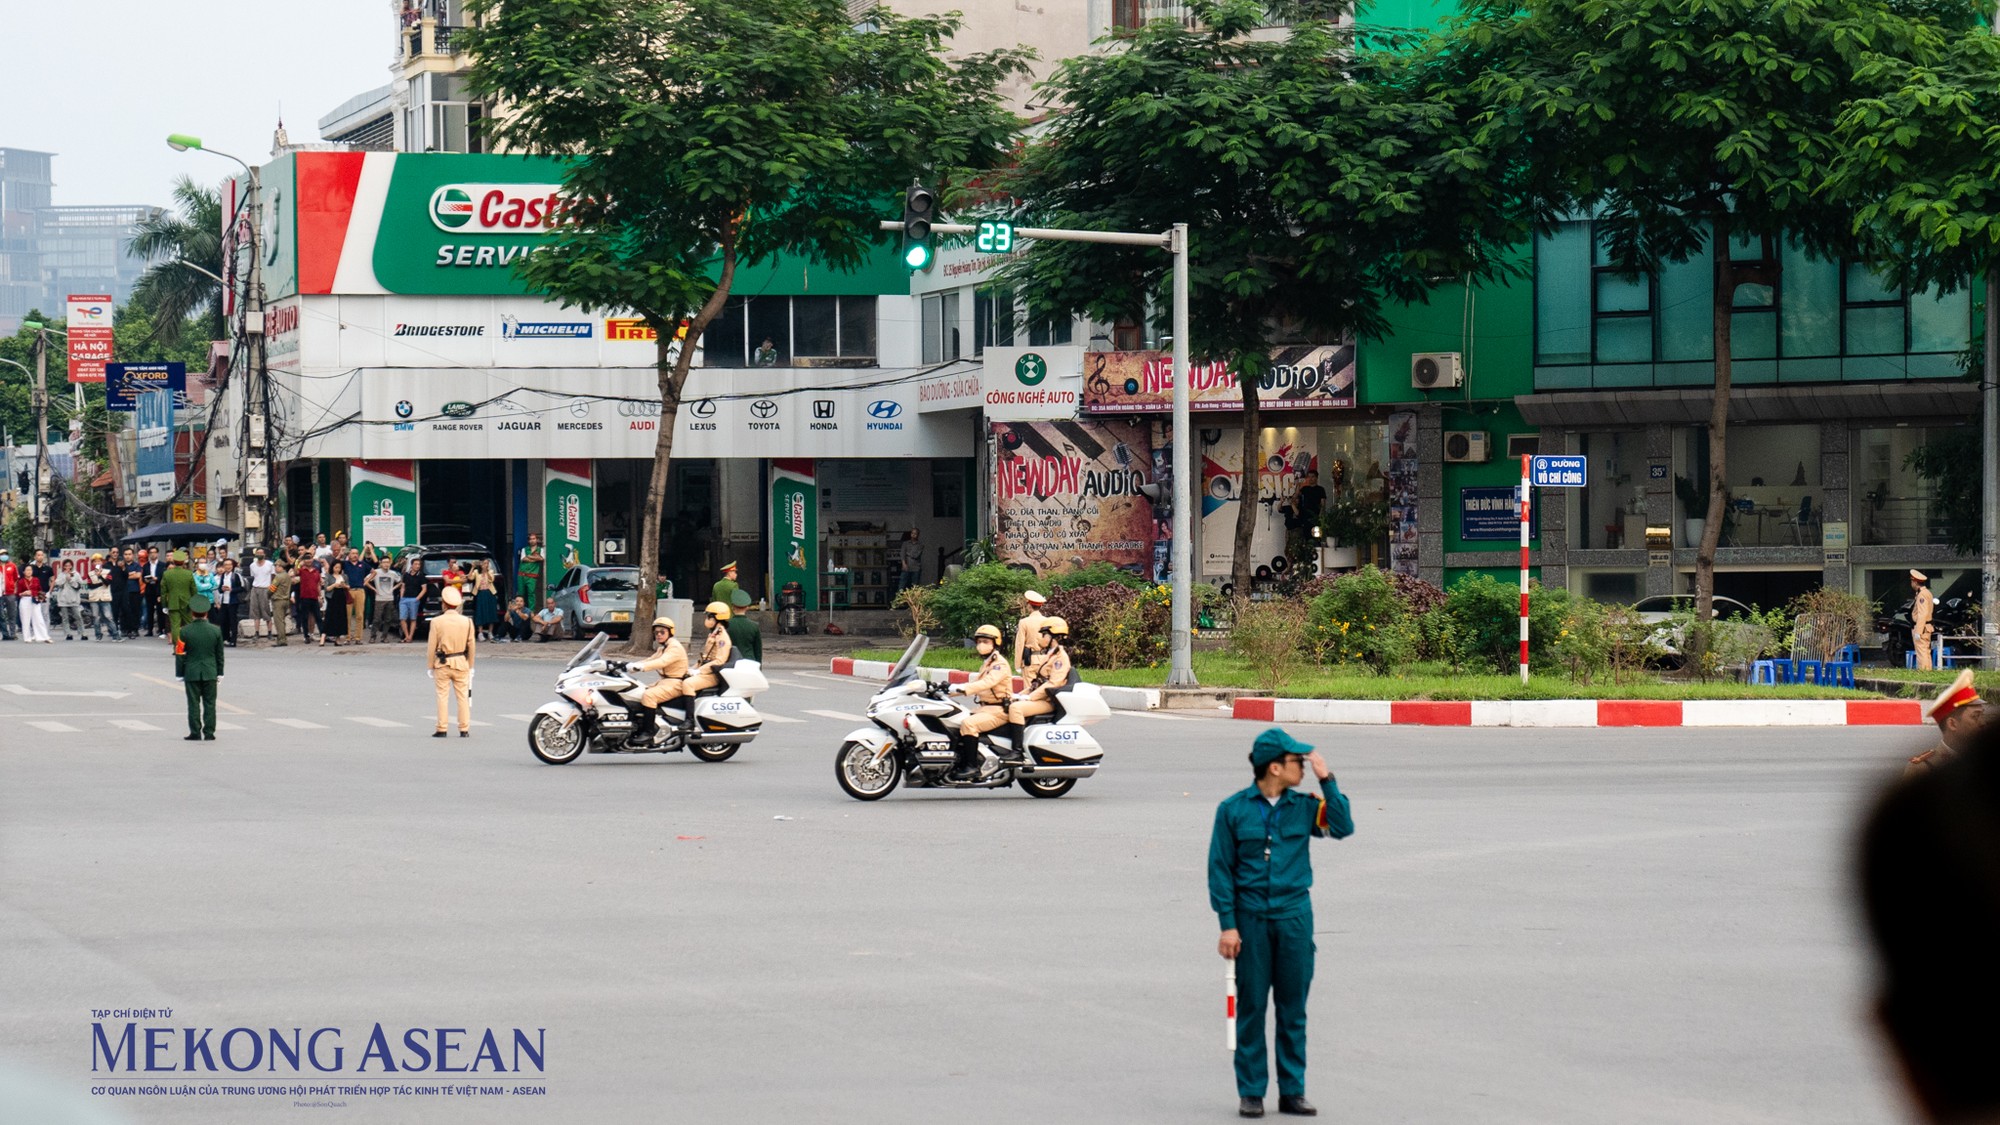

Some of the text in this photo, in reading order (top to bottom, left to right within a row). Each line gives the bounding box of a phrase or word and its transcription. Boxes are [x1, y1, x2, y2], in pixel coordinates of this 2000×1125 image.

[479, 189, 602, 229] Cast
[978, 222, 1011, 251] 23
[393, 323, 485, 337] BRIDGESTONE
[519, 325, 590, 334] MICHELIN
[607, 319, 690, 339] PIRE
[74, 341, 107, 352] HÀ NỘI
[71, 353, 110, 361] GARAGE
[1019, 354, 1042, 364] CMT
[919, 380, 931, 402] BẢO
[931, 379, 951, 400] DƯỠNG
[953, 374, 964, 398] SỬA
[964, 374, 979, 397] CHỮA
[986, 388, 1075, 407] CÔNG NGHỆ AUTO
[394, 423, 414, 431] BMW
[497, 422, 541, 430] JAGUAR
[557, 422, 603, 430] MERCEDES
[630, 421, 655, 430] AUDI
[748, 422, 780, 430] TOYOTA
[810, 422, 838, 430] HONDA
[867, 422, 903, 430] HYUNDAI
[1551, 458, 1580, 468] ĐƯỜNG
[998, 455, 1081, 499] NEWDAY
[1538, 470, 1582, 483] VÕ CHÍ CÔNG
[1228, 473, 1295, 499] MSIC
[568, 505, 578, 538] Castrol
[793, 502, 803, 536] Castrol
[1107, 541, 1144, 549] KARAOKE
